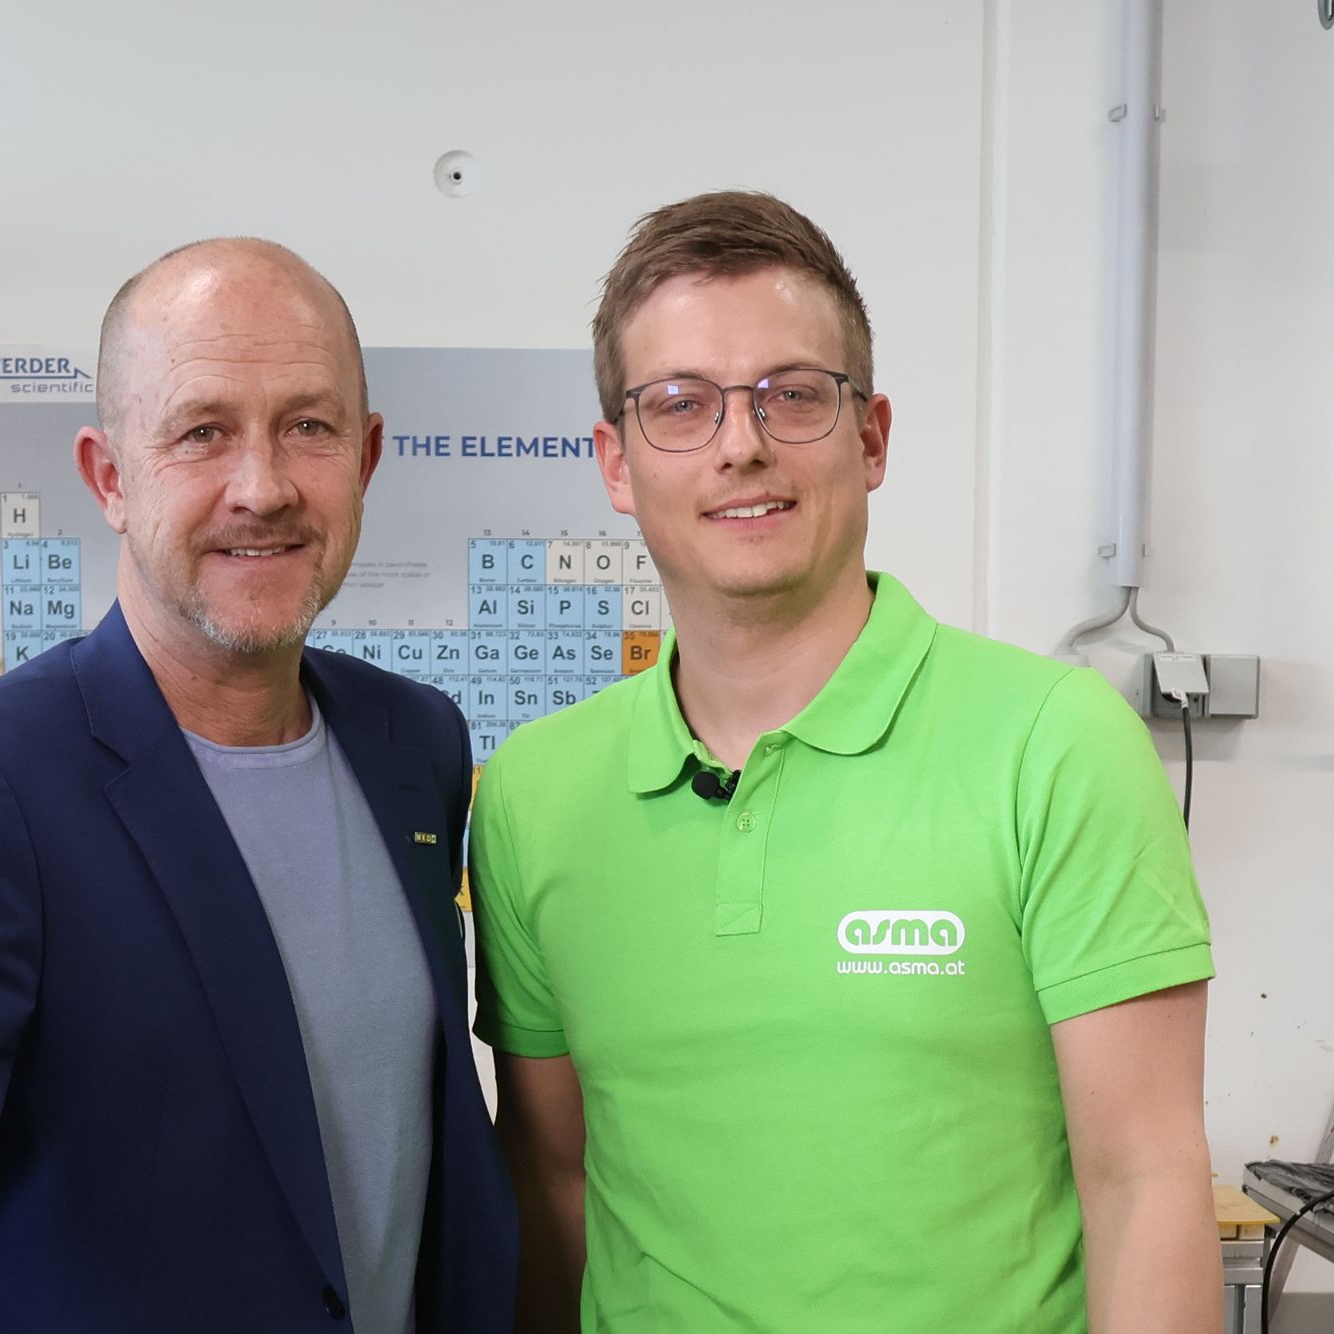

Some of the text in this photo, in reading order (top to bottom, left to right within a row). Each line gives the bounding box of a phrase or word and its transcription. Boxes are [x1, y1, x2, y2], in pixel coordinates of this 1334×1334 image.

[10, 381, 94, 393] scientific
[392, 435, 451, 457] THE
[13, 508, 26, 523] H
[13, 554, 29, 569] Li
[48, 554, 72, 569] Be
[482, 554, 495, 569] B
[521, 554, 534, 569] C
[559, 554, 571, 569] N
[596, 555, 611, 570] O
[636, 555, 647, 570] F
[471, 586, 482, 594] 13
[510, 586, 521, 594] 14
[549, 587, 559, 595] 15
[587, 587, 597, 595] 16
[626, 587, 635, 595] 17
[10, 600, 34, 615] Na
[47, 600, 75, 619] Mg
[478, 600, 497, 615] Al
[517, 600, 535, 615] Si
[559, 600, 571, 615] P
[597, 600, 610, 615] S
[631, 600, 649, 615] Cl
[316, 631, 327, 640] 27
[355, 631, 366, 640] 28
[394, 631, 405, 640] 29
[432, 631, 443, 640] 30
[471, 631, 481, 640] 31
[509, 631, 520, 640] 32
[548, 631, 558, 640] 33
[587, 631, 597, 640] 34
[624, 631, 635, 640] 35
[16, 645, 28, 661] K
[363, 645, 381, 659] Ni
[398, 645, 422, 660] Cu
[436, 645, 460, 660] Zn
[475, 645, 499, 660] Ga
[514, 645, 539, 660] Ge
[552, 645, 576, 660] As
[591, 645, 613, 660] Se
[630, 645, 651, 660] Br
[432, 677, 443, 685] 48
[471, 677, 482, 685] 49
[509, 677, 520, 685] 50
[548, 677, 558, 685] 51
[586, 677, 597, 685] 52
[478, 690, 495, 705] In
[514, 690, 538, 705] Sn
[552, 690, 576, 705] Sb
[479, 735, 495, 750] Tl
[844, 917, 958, 947] asma
[836, 959, 966, 976] www.asma.at
